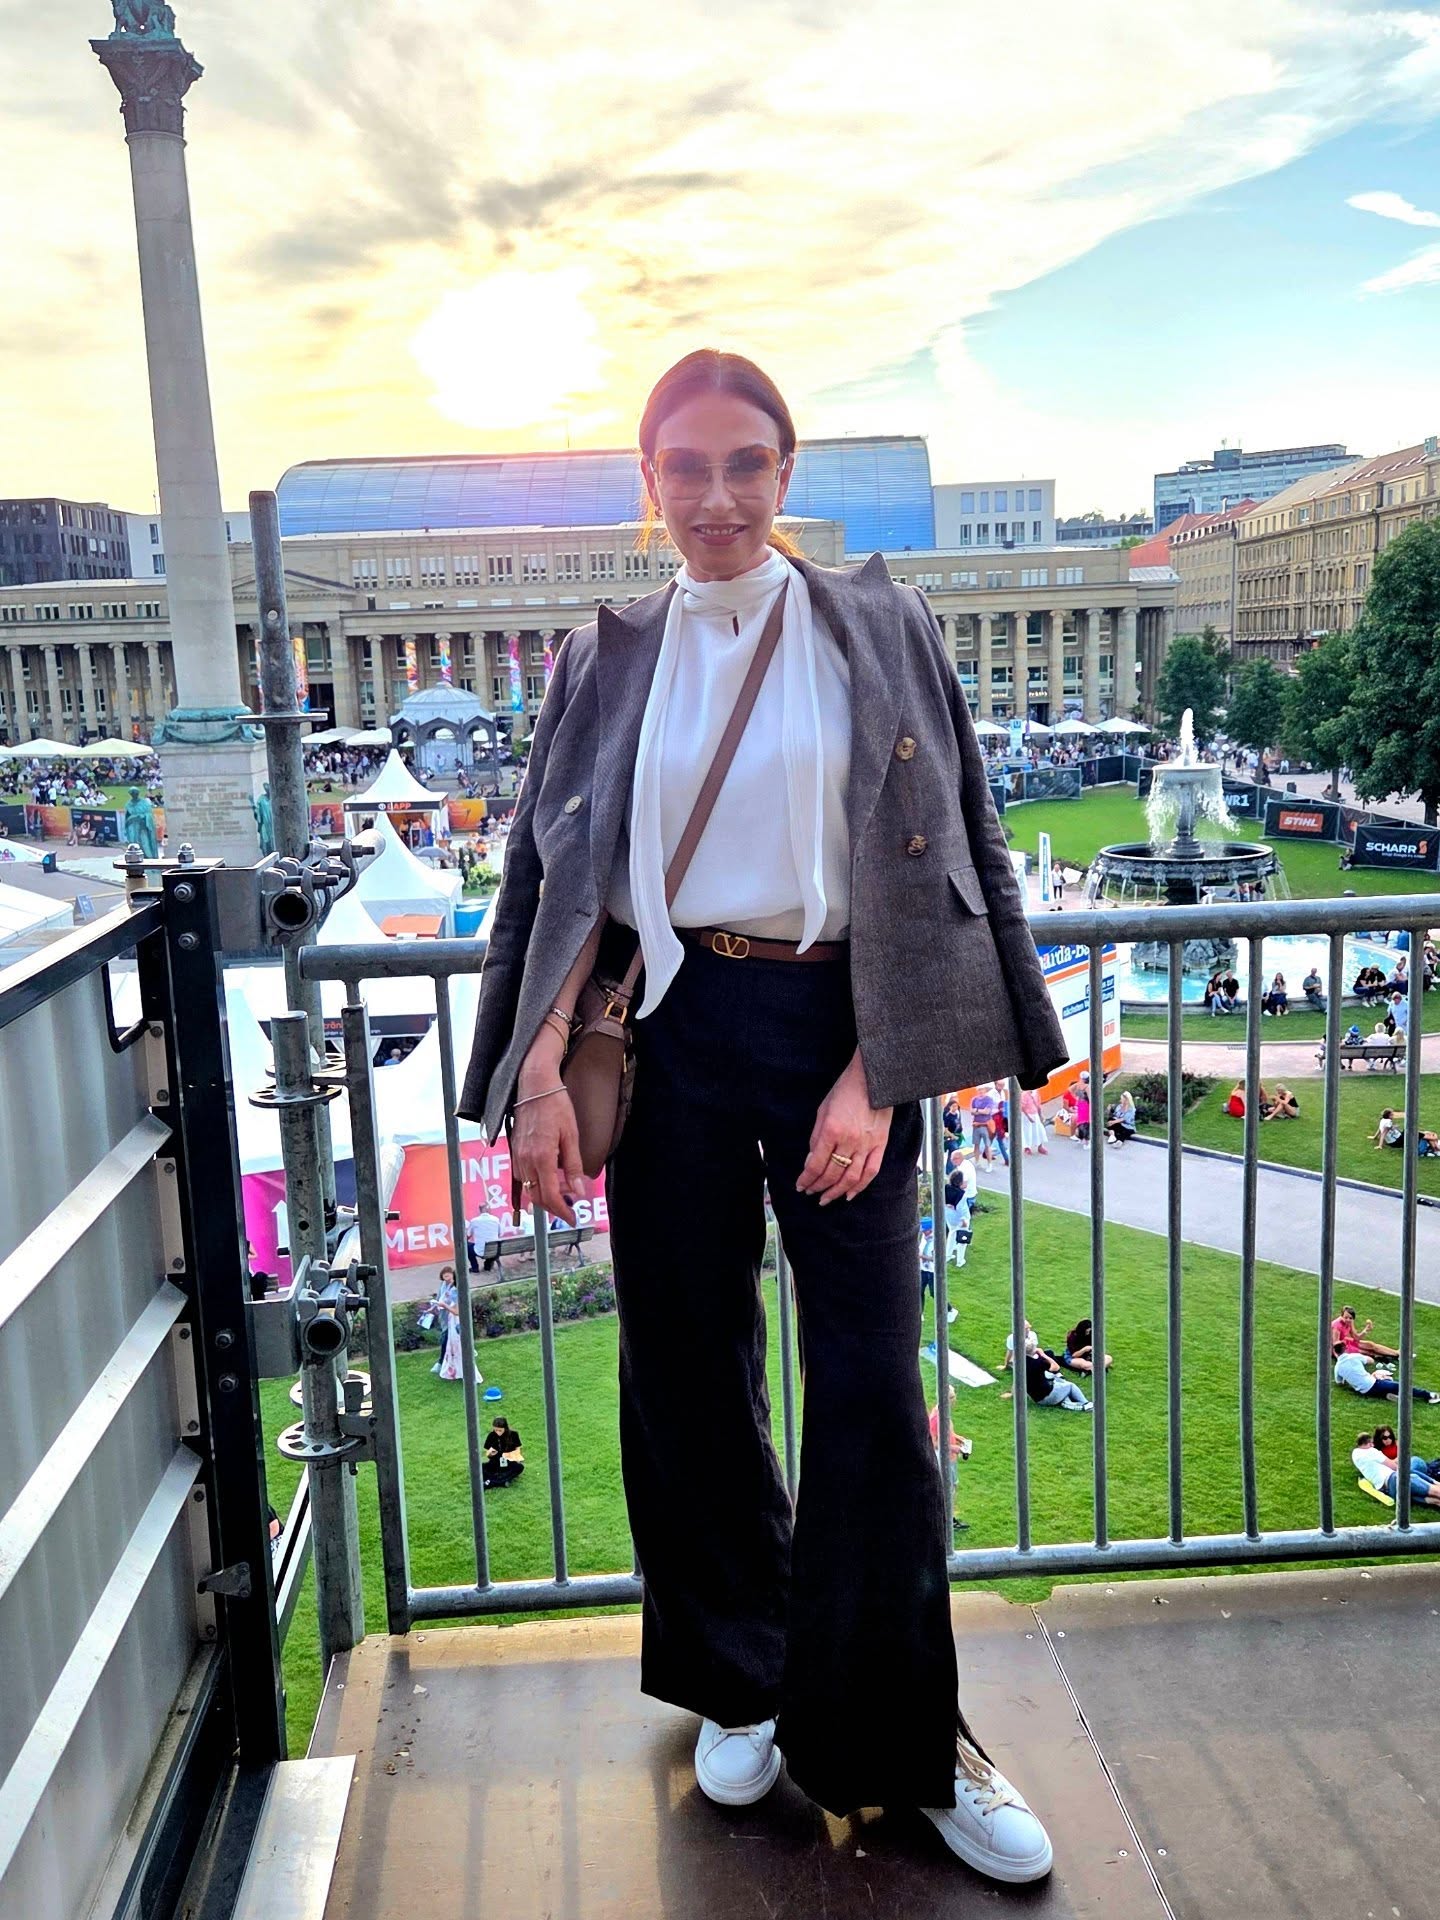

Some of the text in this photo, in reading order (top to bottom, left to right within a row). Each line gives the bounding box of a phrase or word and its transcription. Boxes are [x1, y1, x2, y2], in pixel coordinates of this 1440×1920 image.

[1282, 816, 1319, 828] STIHL
[1365, 842, 1418, 854] SCHARR
[487, 1184, 509, 1209] &
